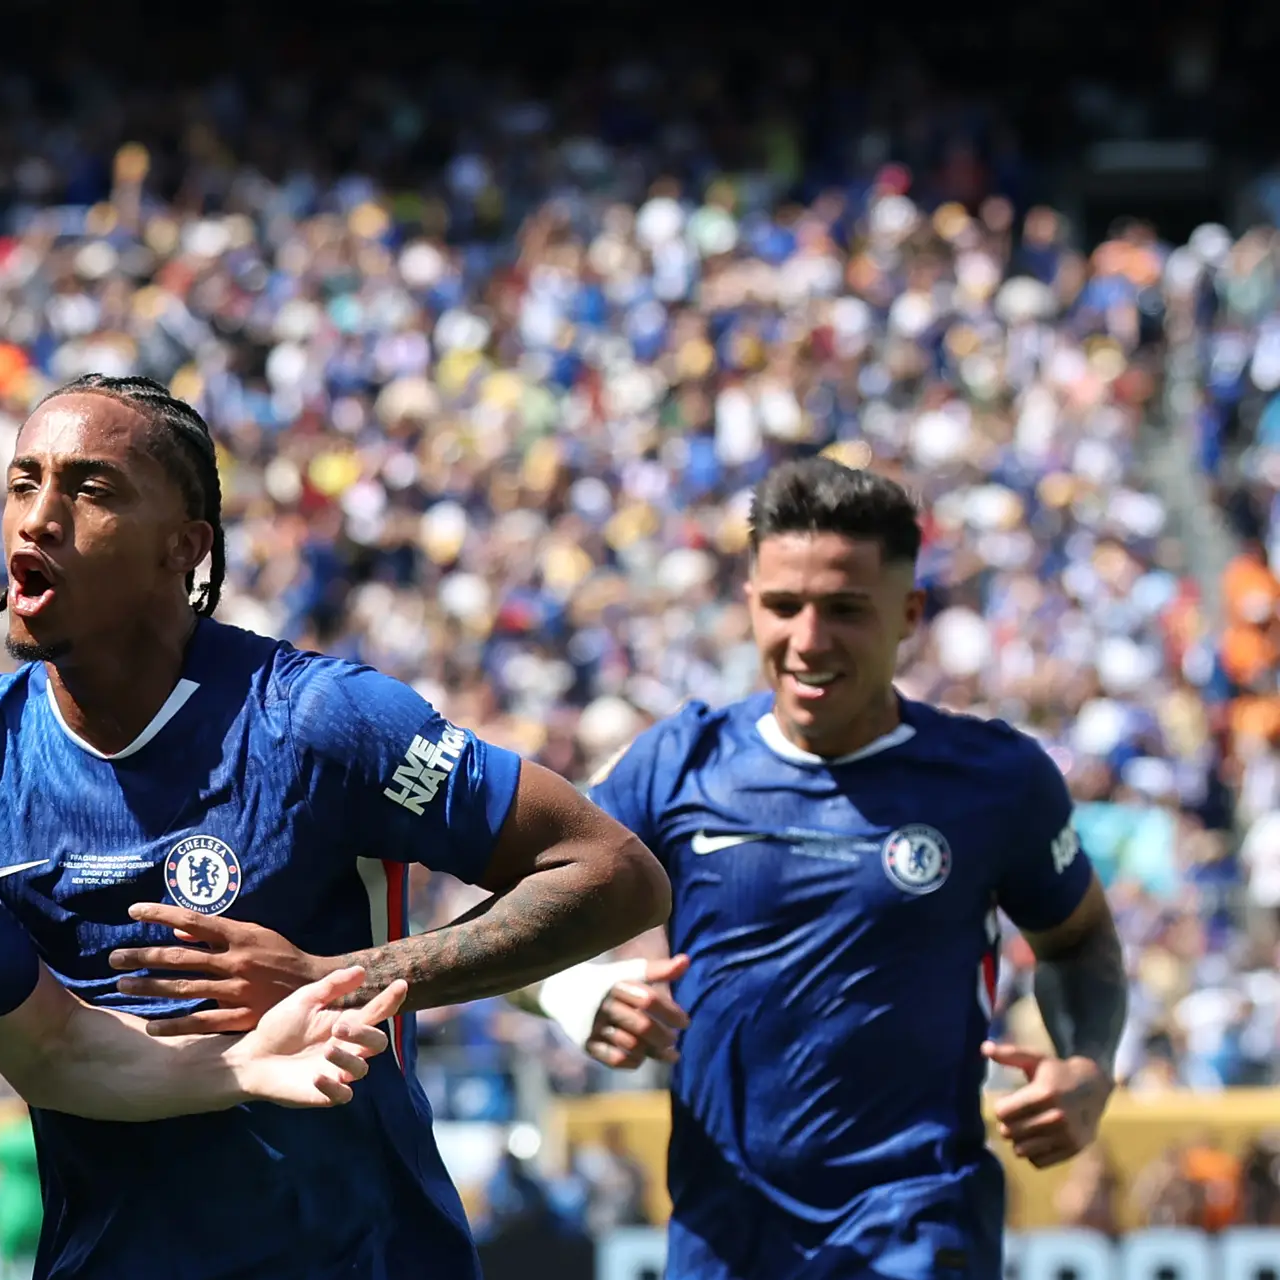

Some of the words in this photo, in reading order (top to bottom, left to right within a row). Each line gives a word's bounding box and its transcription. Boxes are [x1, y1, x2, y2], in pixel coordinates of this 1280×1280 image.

[383, 734, 436, 805] LIVE
[177, 839, 227, 857] CHELSEA
[178, 896, 209, 913] FOOTBALL
[211, 899, 227, 911] CLUB
